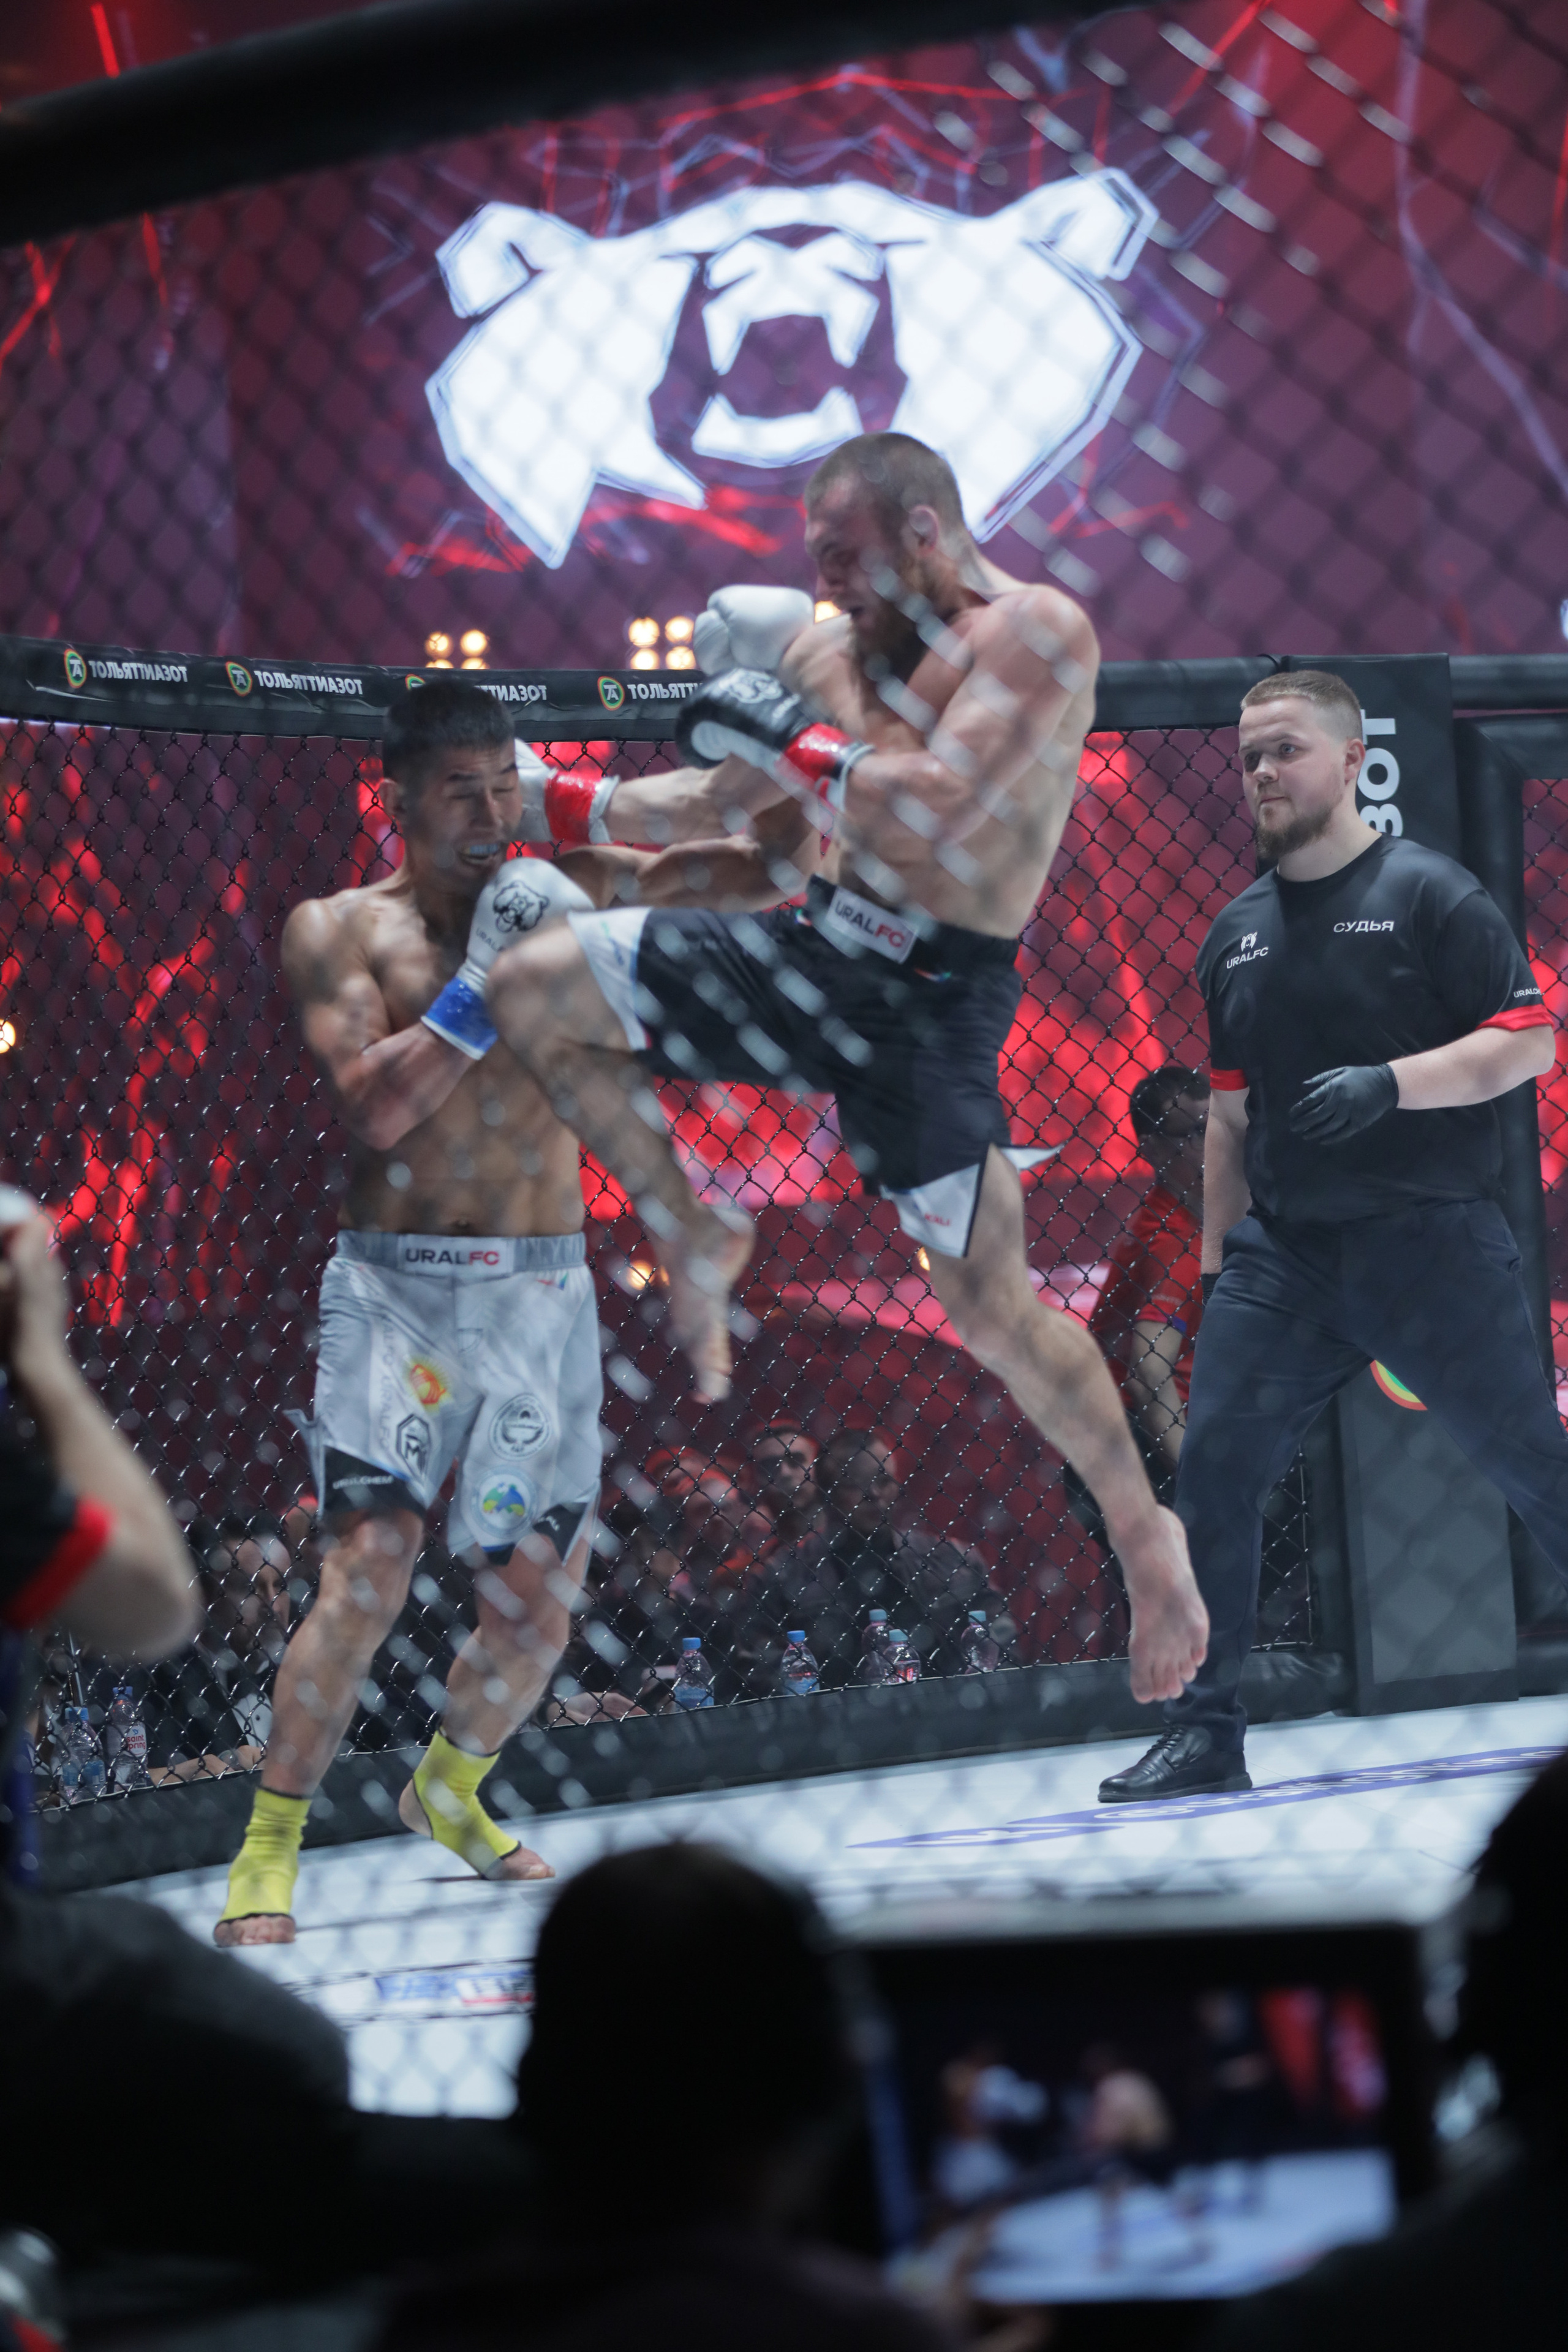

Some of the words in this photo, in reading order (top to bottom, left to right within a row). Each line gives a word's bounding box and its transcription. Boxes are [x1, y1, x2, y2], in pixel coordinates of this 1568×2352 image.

[88, 660, 188, 682] ТОЛЬЯТТИАЗОТ
[254, 670, 363, 695] ТОЛЬЯТТИАЗОТ
[627, 682, 703, 699] ТОЛЬЯТТ
[835, 900, 905, 948] URALFC
[1333, 920, 1395, 933] СУДЬЯ
[1226, 946, 1269, 970] URALFC
[405, 1248, 500, 1266] URALFC
[126, 1734, 144, 1743] saint
[127, 1741, 146, 1751] pring
